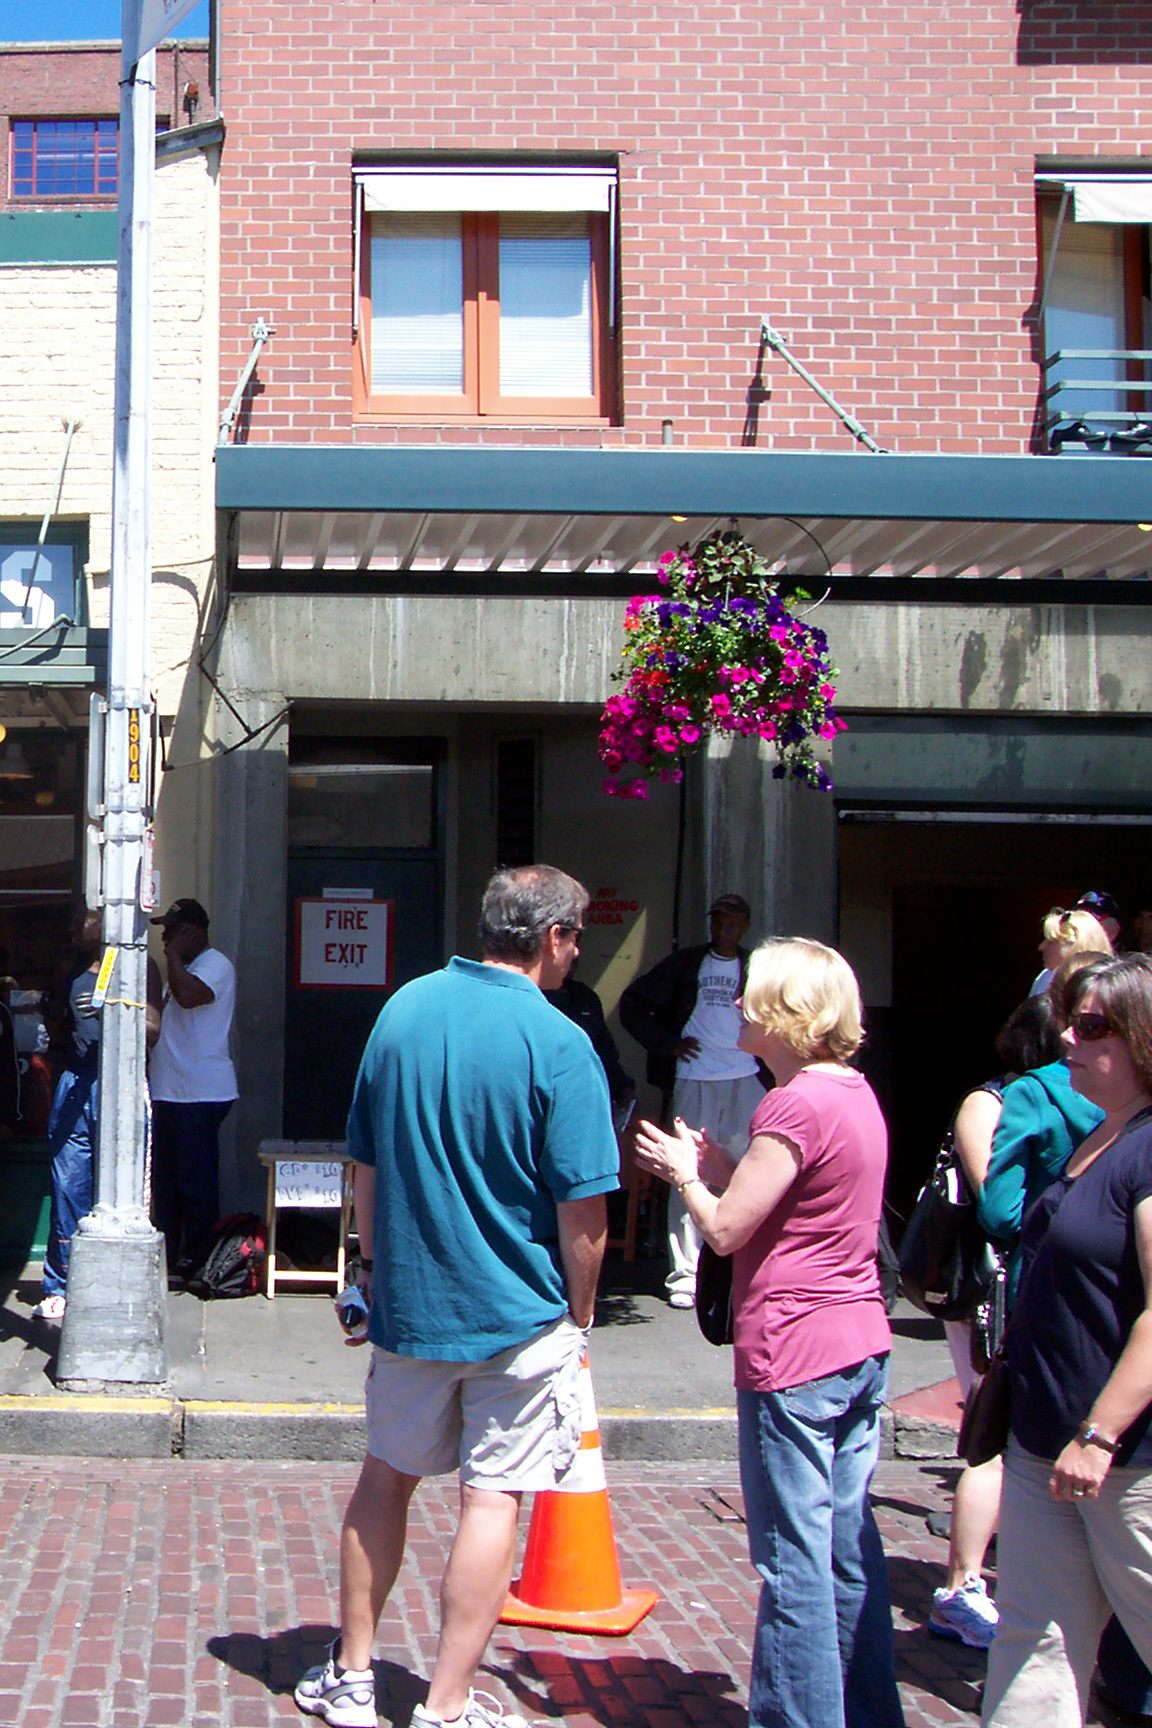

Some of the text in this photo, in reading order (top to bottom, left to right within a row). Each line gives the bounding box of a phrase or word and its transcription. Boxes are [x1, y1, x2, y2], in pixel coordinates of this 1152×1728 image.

[129, 709, 140, 783] 1904
[325, 910, 368, 930] FIRE
[325, 943, 368, 964] EXIT
